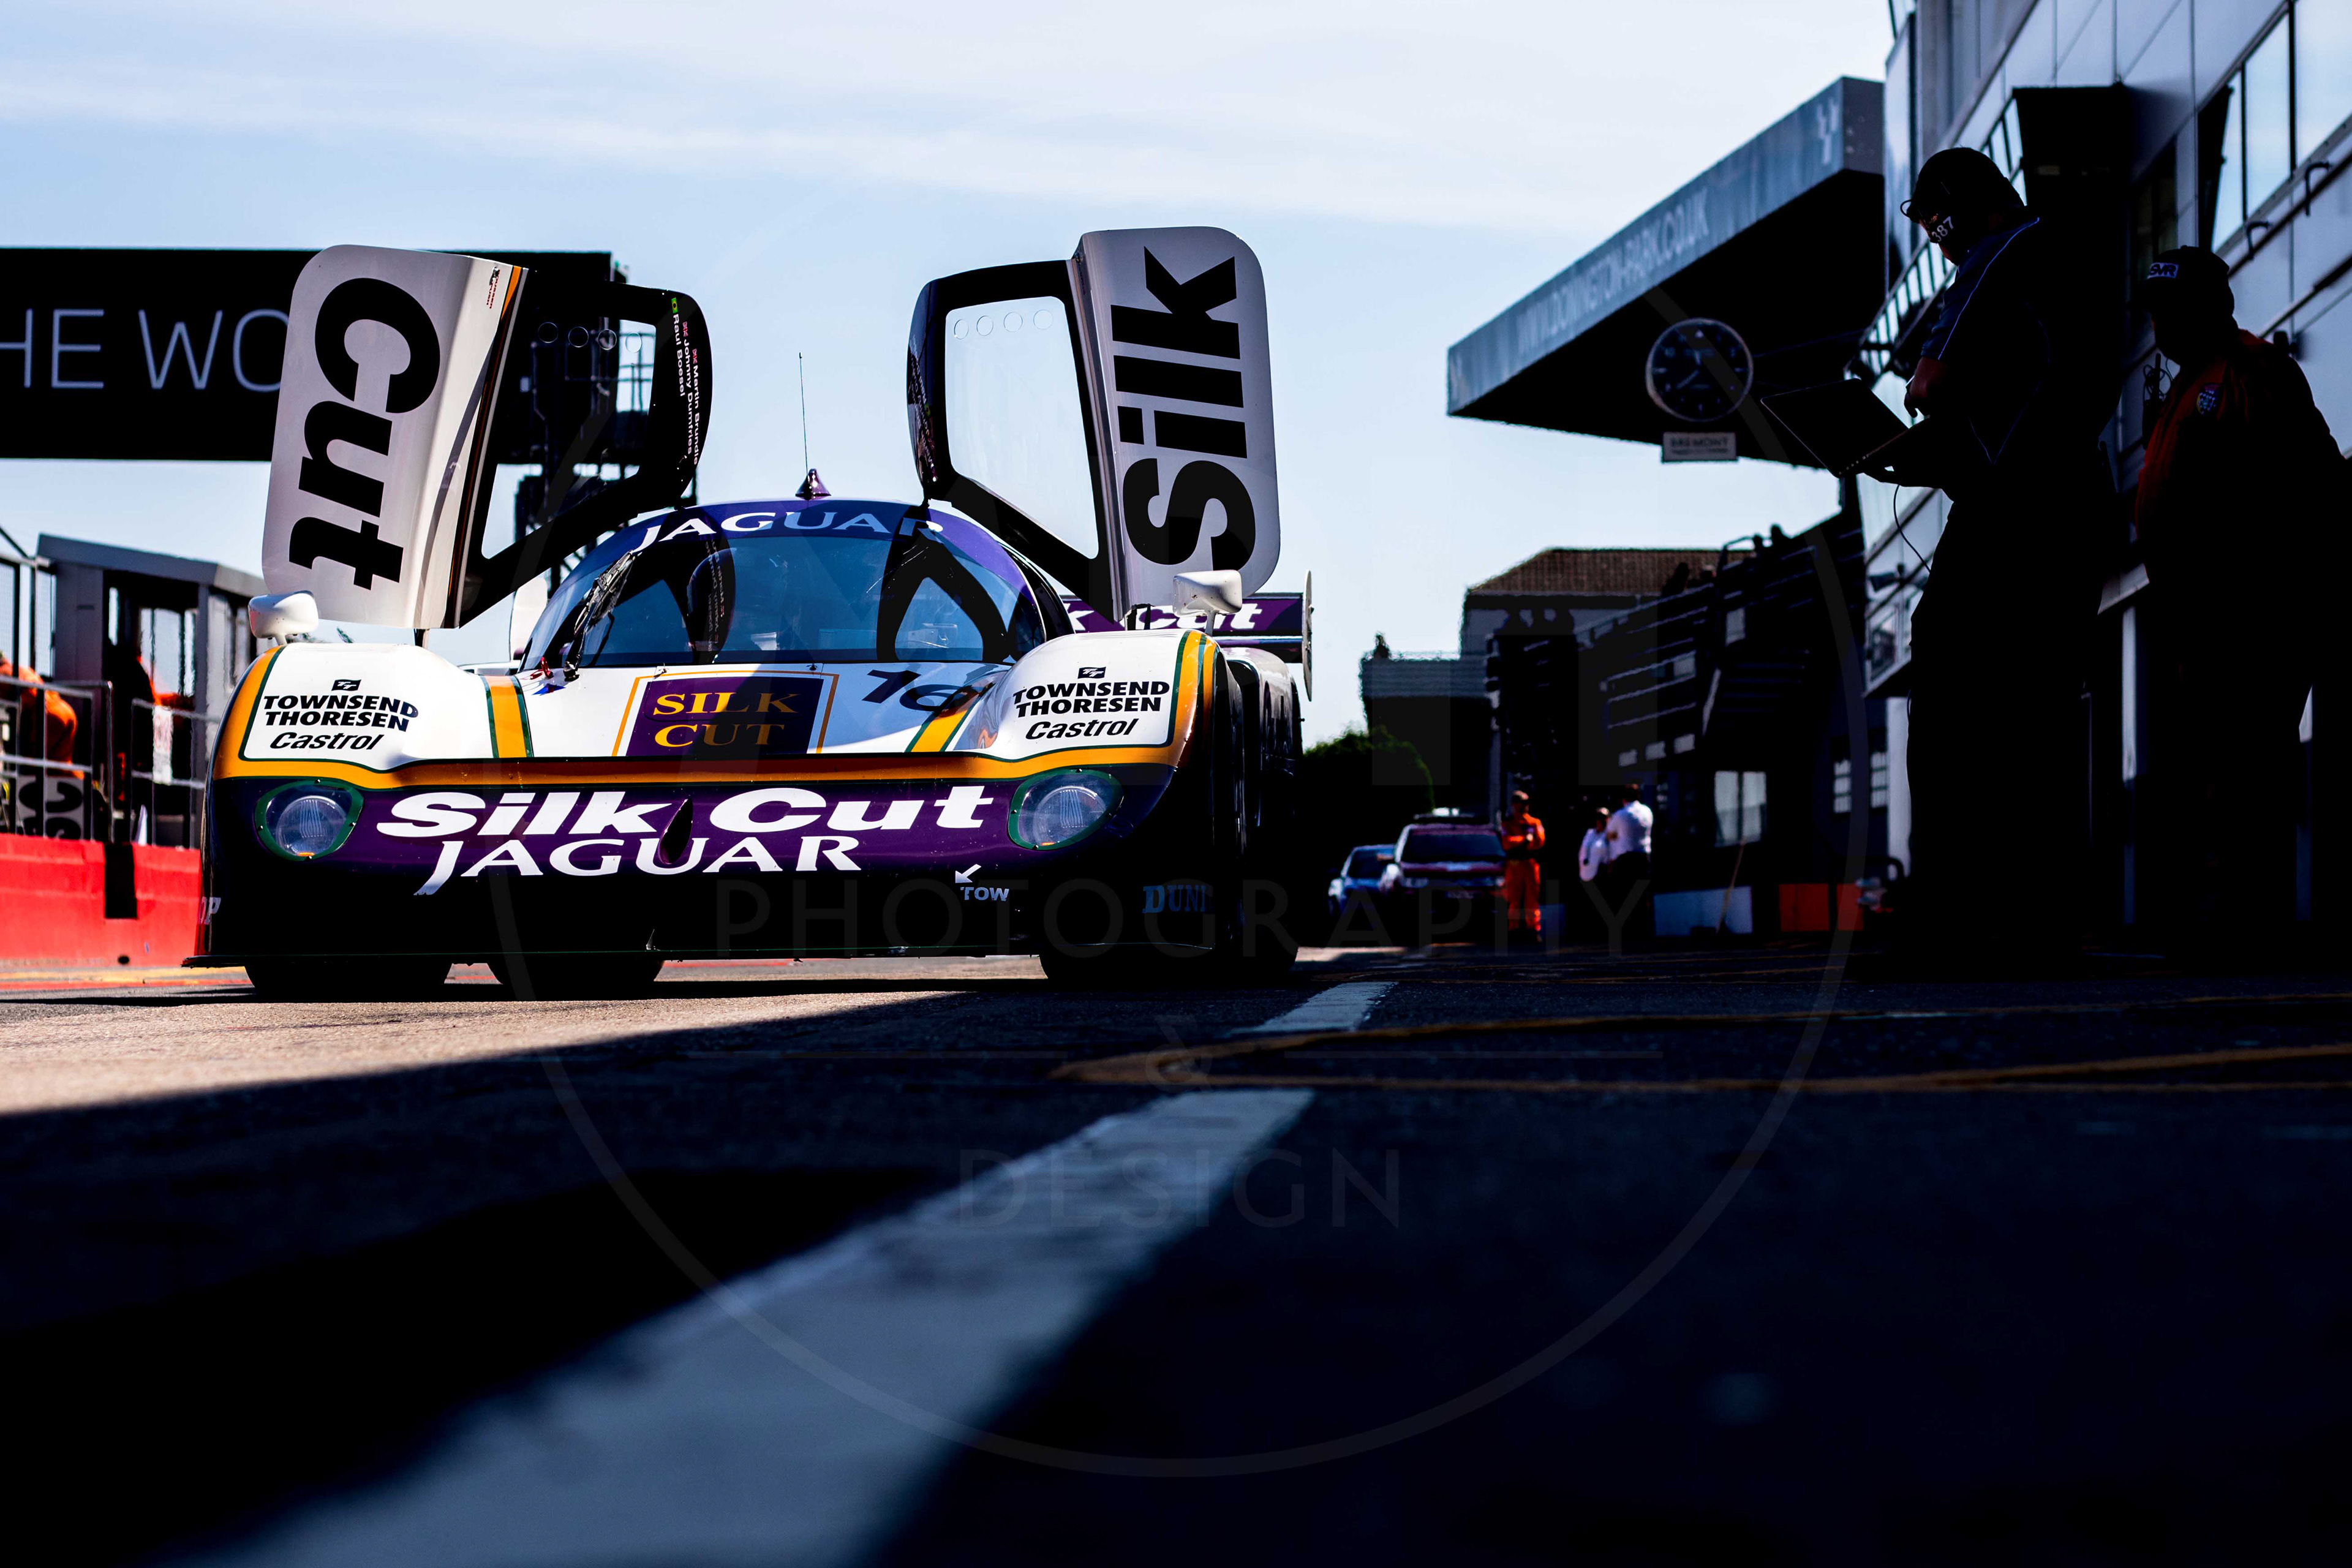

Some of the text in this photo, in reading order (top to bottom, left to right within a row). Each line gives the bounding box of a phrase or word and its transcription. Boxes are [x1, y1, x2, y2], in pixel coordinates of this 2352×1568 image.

[1931, 216, 1954, 243] 387
[673, 314, 686, 397] Raul Boesel
[684, 339, 692, 388] Johnny
[1110, 245, 1256, 571] Silk
[288, 277, 441, 591] Cut
[631, 511, 945, 554] JAGUAR
[653, 692, 801, 715] SILK
[1012, 680, 1170, 704] TOWNSEND
[263, 695, 418, 718] TOWNSEND
[1016, 696, 1162, 718] THORESEN
[265, 710, 410, 732] THORESEN
[1025, 718, 1139, 740] Castrol
[270, 732, 385, 750] Castrol
[654, 723, 785, 747] CUT
[376, 785, 993, 838] Silk Cut
[413, 835, 861, 896] JAGUAR
[960, 886, 1010, 902] TOW
